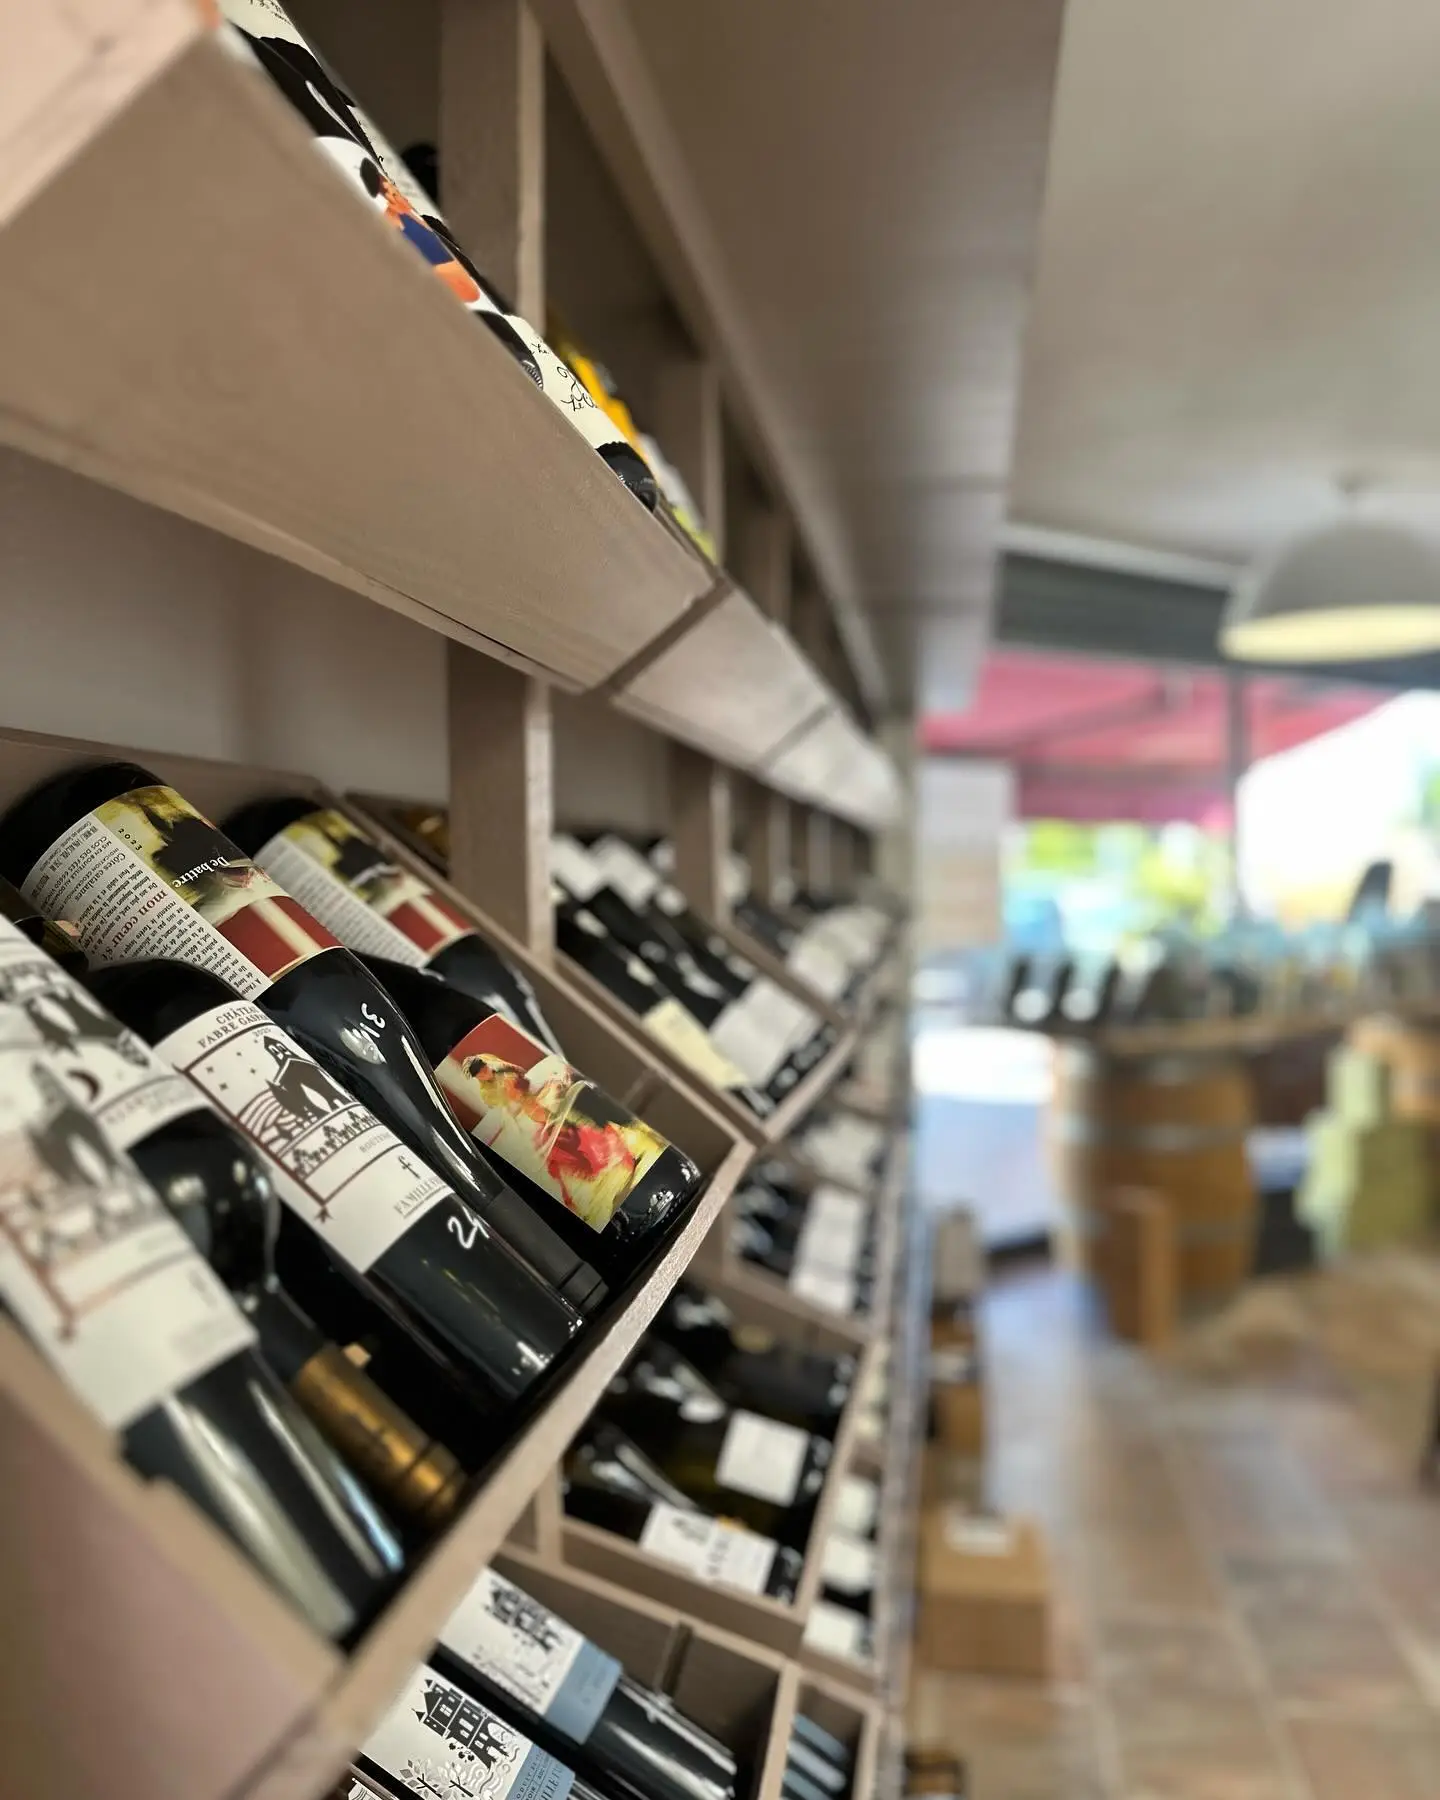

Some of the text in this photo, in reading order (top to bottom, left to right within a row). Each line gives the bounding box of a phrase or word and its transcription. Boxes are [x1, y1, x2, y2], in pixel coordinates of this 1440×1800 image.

[117, 828, 143, 851] 2023
[80, 848, 92, 860] DES
[103, 853, 125, 871] Côtes
[172, 856, 231, 888] De battre
[74, 870, 103, 902] catalanes
[137, 890, 167, 916] mon
[111, 916, 138, 947] cœur
[197, 1022, 238, 1049] FABRE
